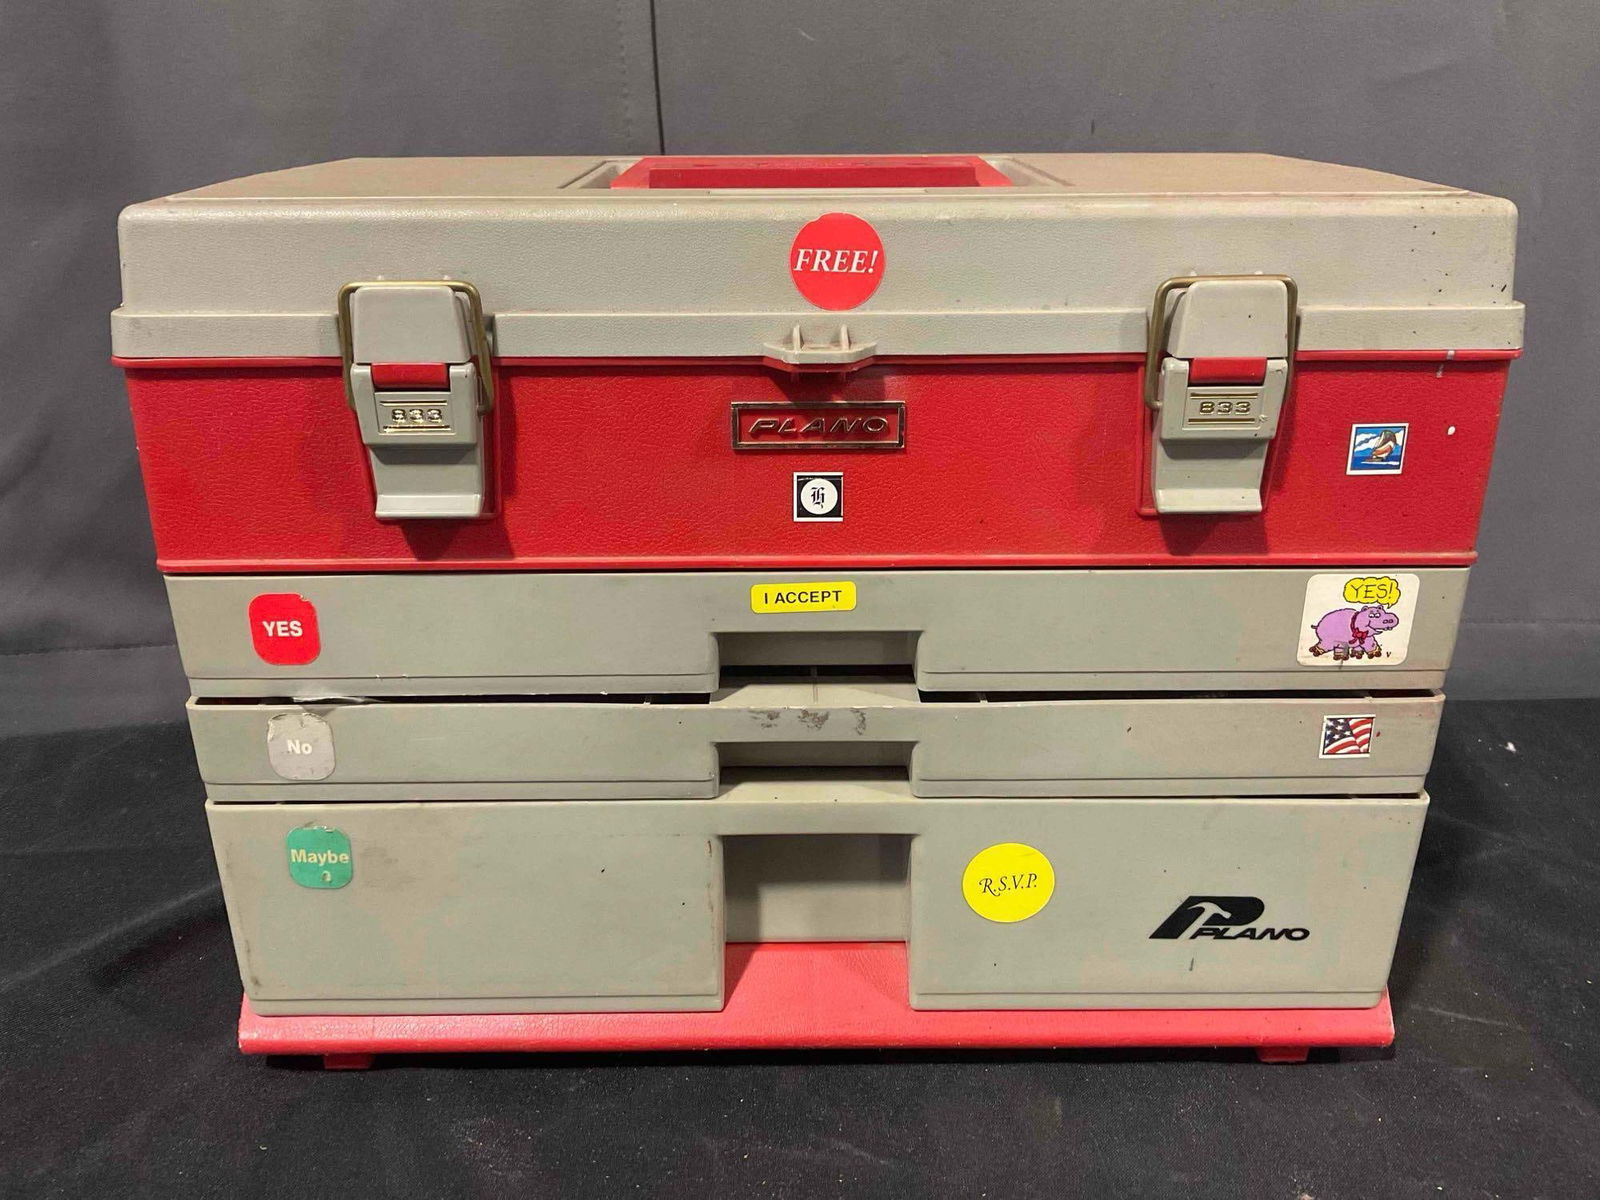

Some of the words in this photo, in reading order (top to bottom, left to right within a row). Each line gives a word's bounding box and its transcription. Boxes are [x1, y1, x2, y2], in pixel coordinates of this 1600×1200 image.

[793, 248, 879, 274] FREE!
[391, 408, 442, 423] 833
[1199, 401, 1251, 415] 833
[748, 415, 889, 434] PLANO
[763, 592, 769, 605] I
[774, 590, 842, 605] ACCEPT
[1350, 582, 1394, 600] YES!
[262, 620, 303, 637] YES
[287, 739, 313, 755] No
[290, 848, 350, 867] Maybe
[978, 873, 1038, 897] R.S.V.P.
[1189, 927, 1310, 941] PLANO
